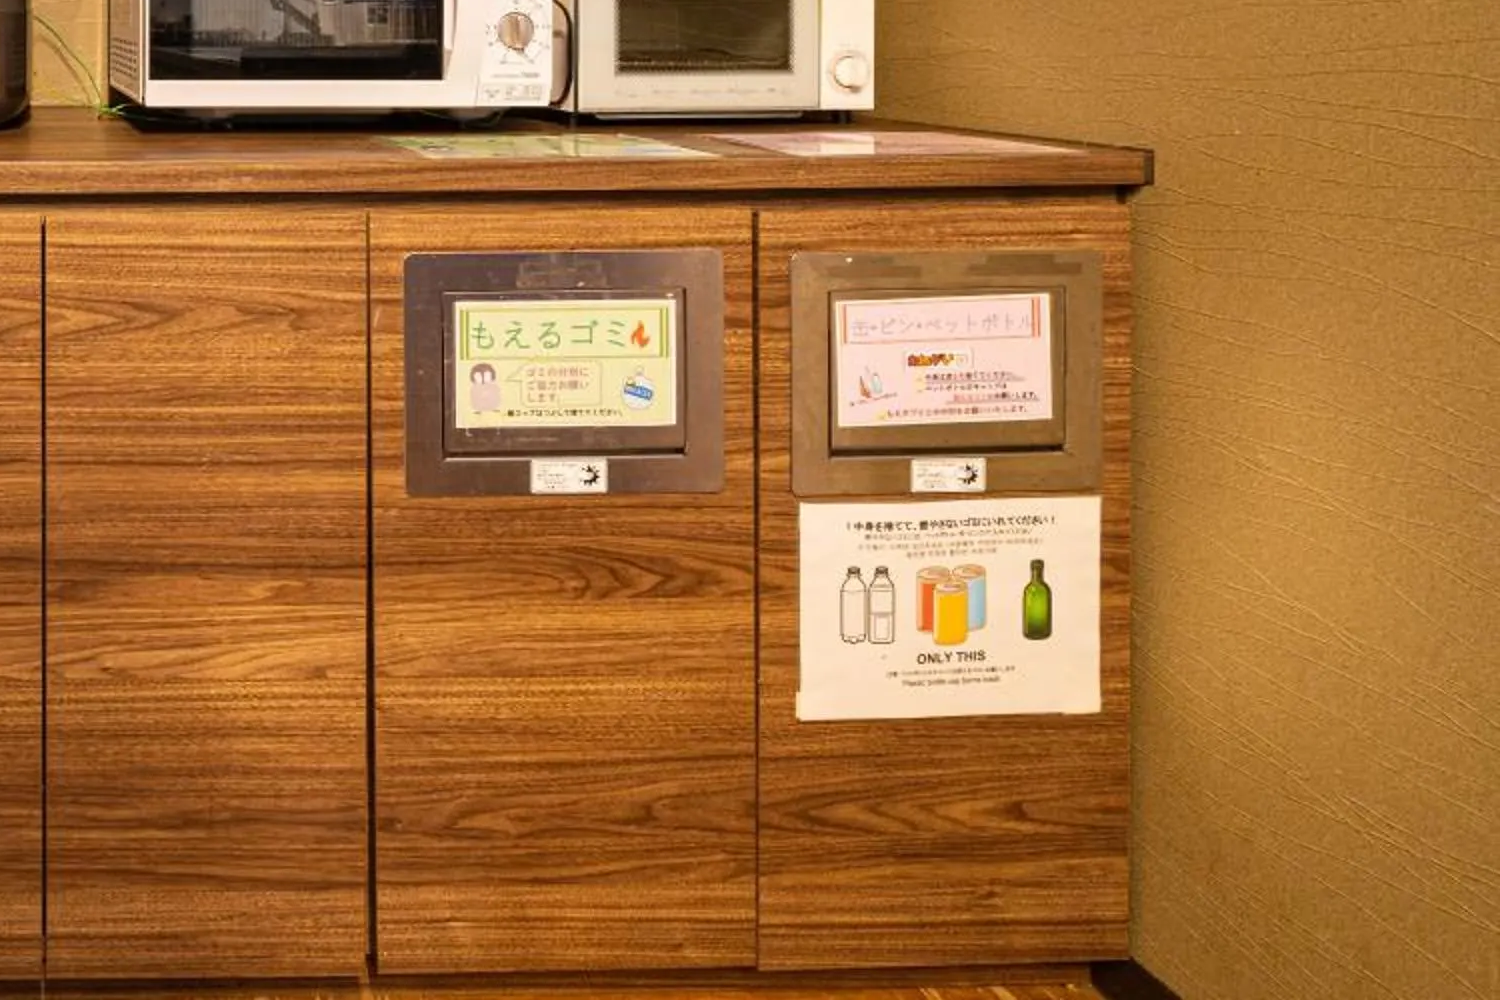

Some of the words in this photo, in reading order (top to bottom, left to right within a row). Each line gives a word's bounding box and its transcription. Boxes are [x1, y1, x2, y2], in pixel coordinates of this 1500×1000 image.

[471, 320, 626, 349] もえるゴミ
[916, 651, 952, 665] ONLY
[956, 649, 987, 663] THIS
